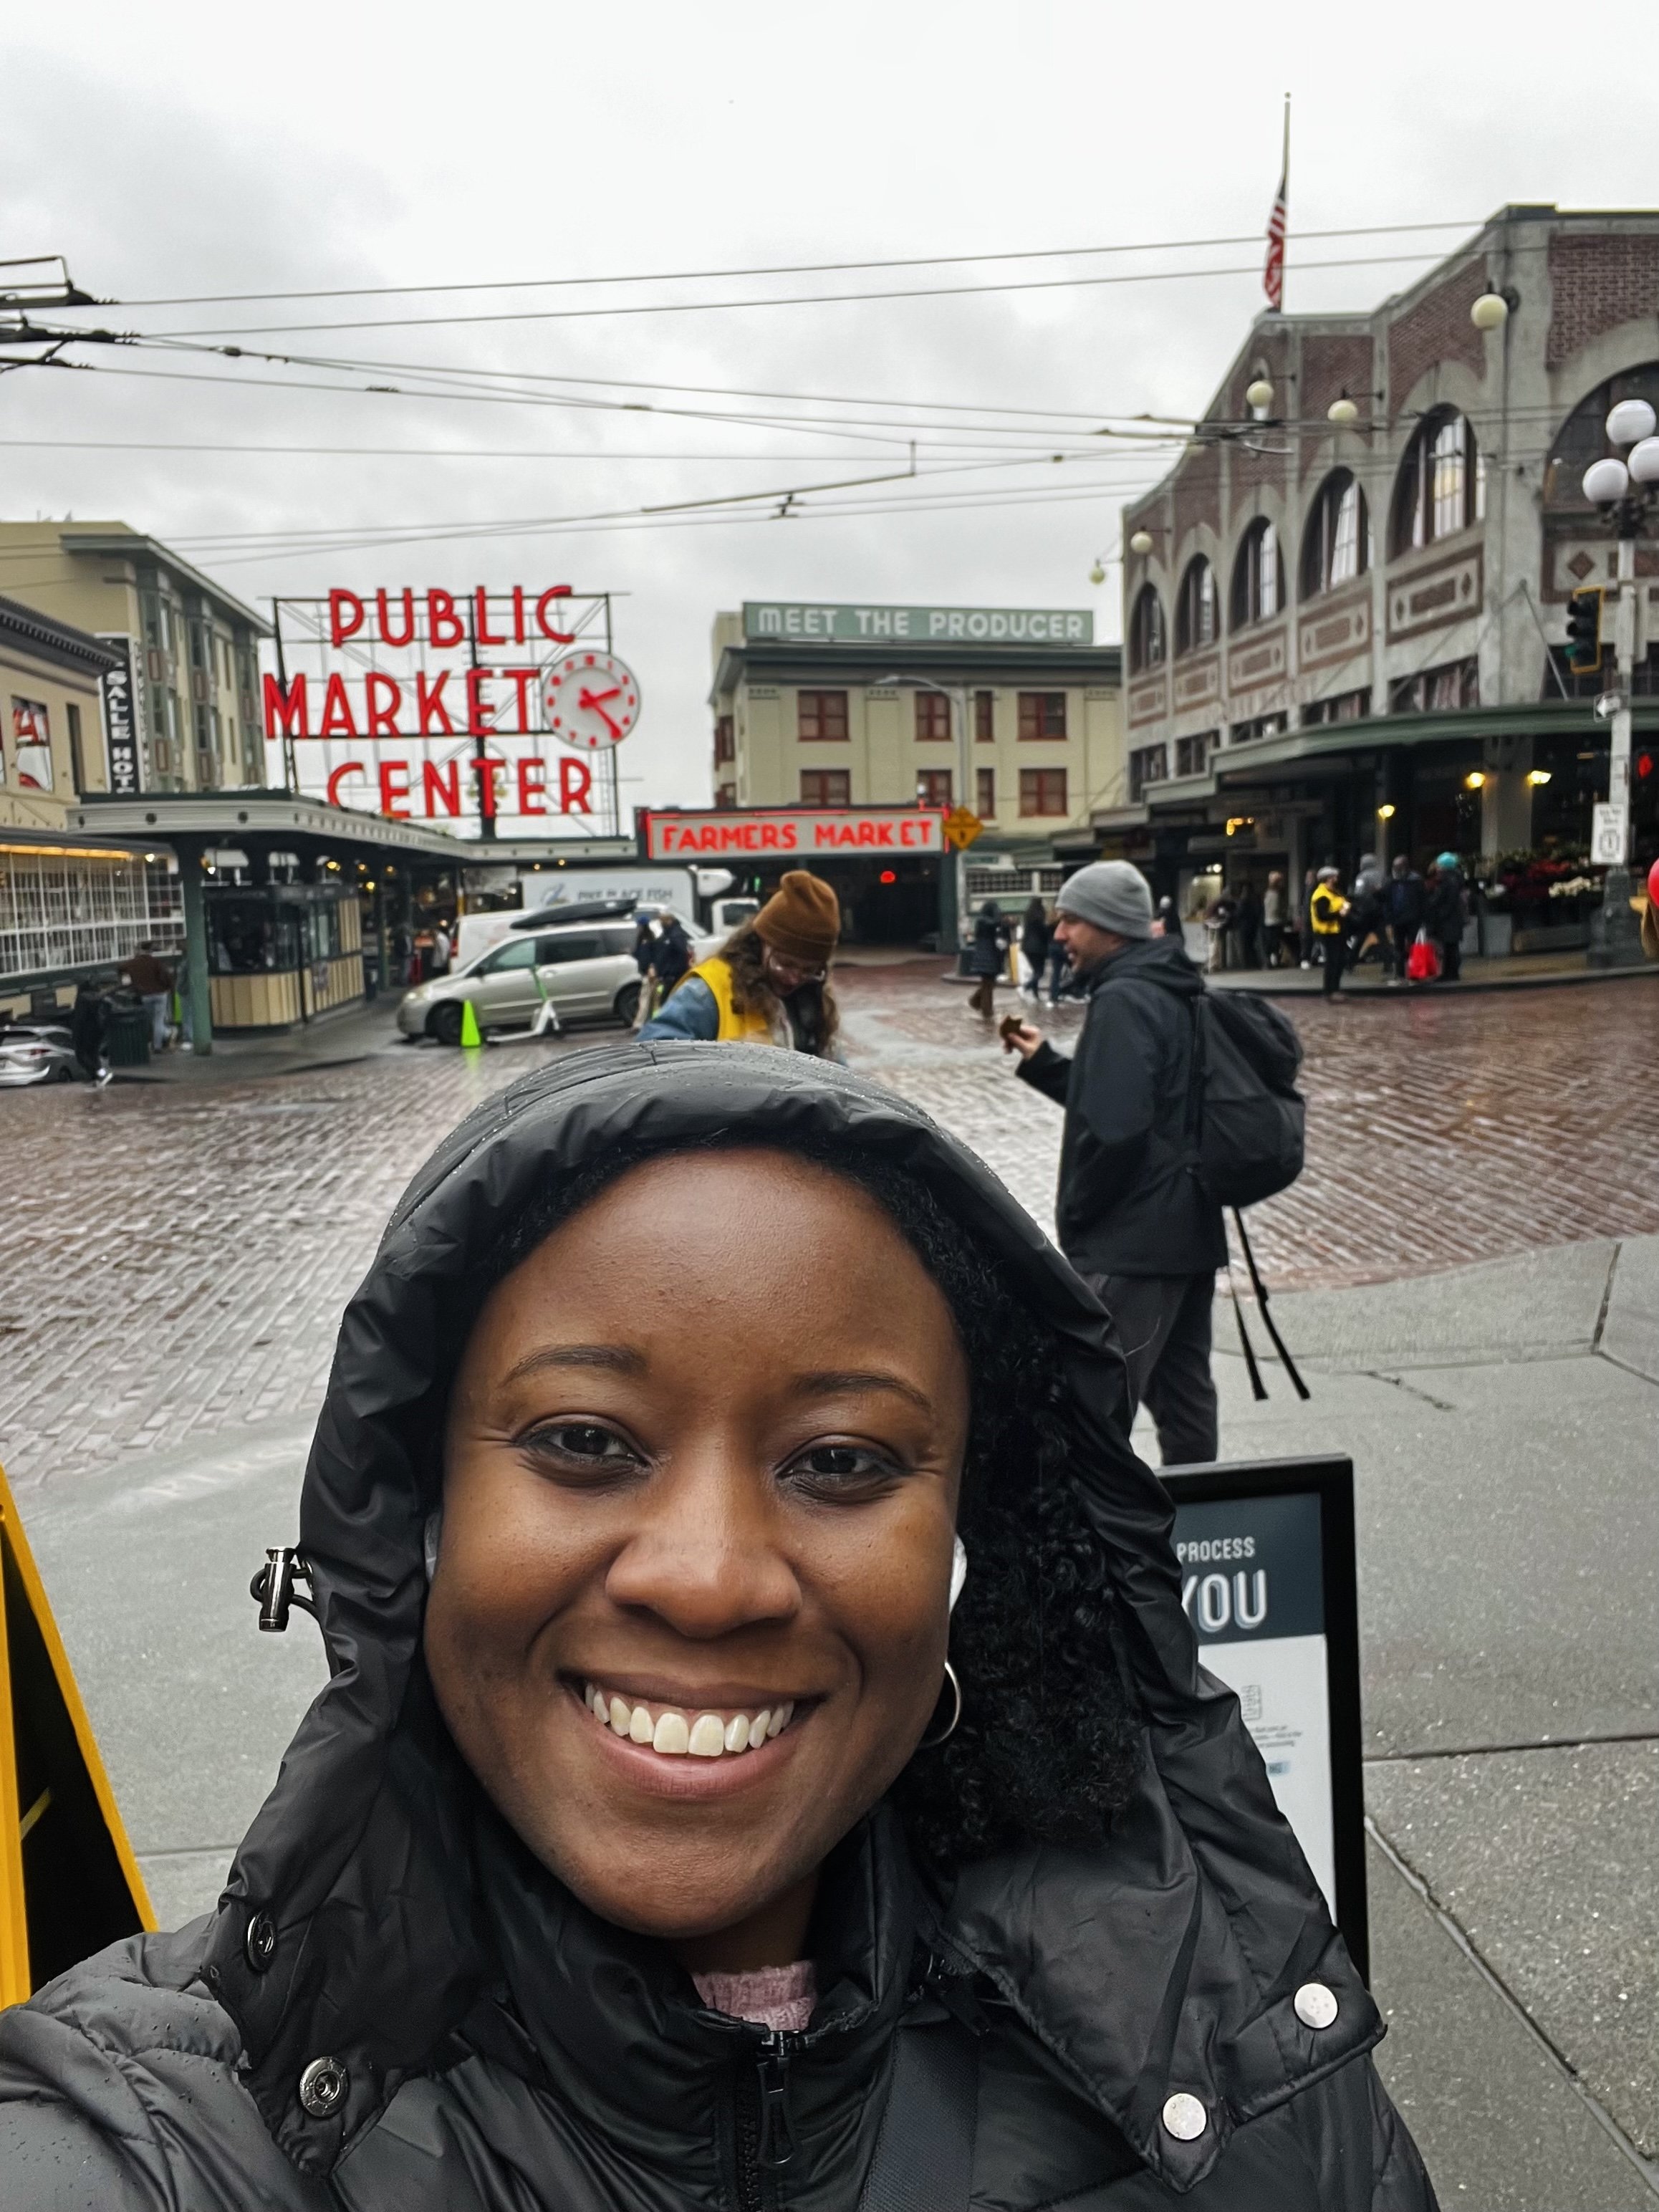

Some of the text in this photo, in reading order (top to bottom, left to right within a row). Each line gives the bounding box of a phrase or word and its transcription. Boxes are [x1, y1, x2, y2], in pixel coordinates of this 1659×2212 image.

[329, 585, 574, 648] PUBLIC
[758, 607, 1086, 638] MEET THE PRODUCER
[106, 670, 131, 740] SALLE
[263, 668, 540, 739] MARKET
[327, 756, 592, 819] CENTER
[662, 819, 933, 852] FARMERS MARKET
[1176, 1536, 1256, 1564] PROCESS
